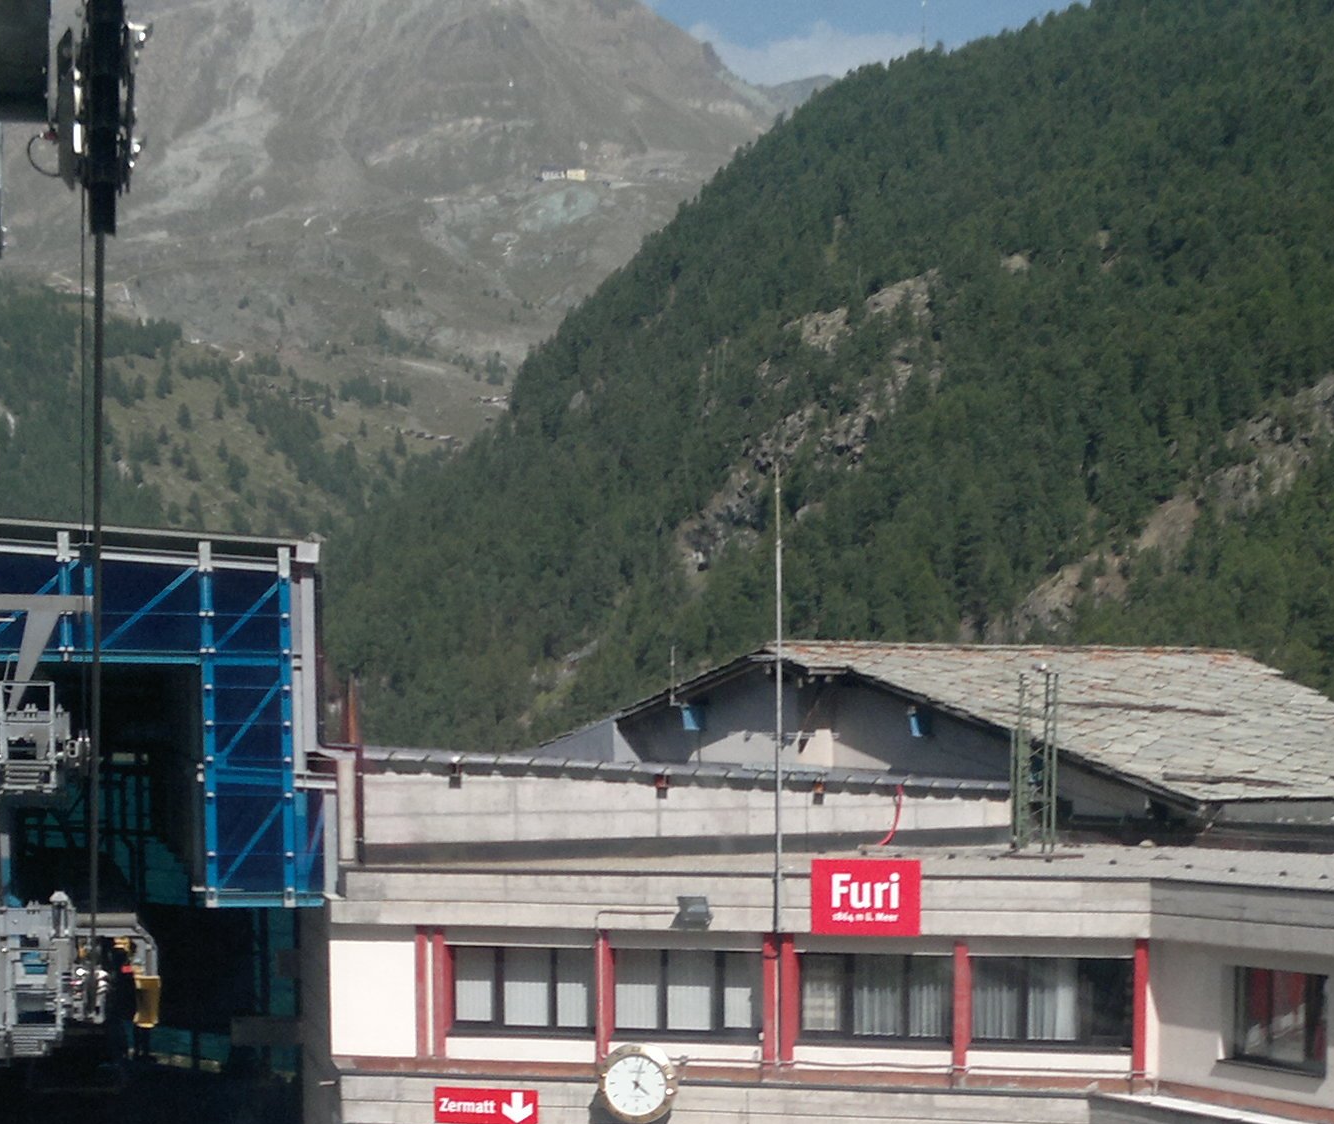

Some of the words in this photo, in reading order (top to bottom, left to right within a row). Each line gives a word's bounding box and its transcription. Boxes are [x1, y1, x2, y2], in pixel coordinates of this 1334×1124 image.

[831, 872, 900, 909] Furi
[875, 912, 899, 922] Meer
[438, 1096, 496, 1115] Zermatt
